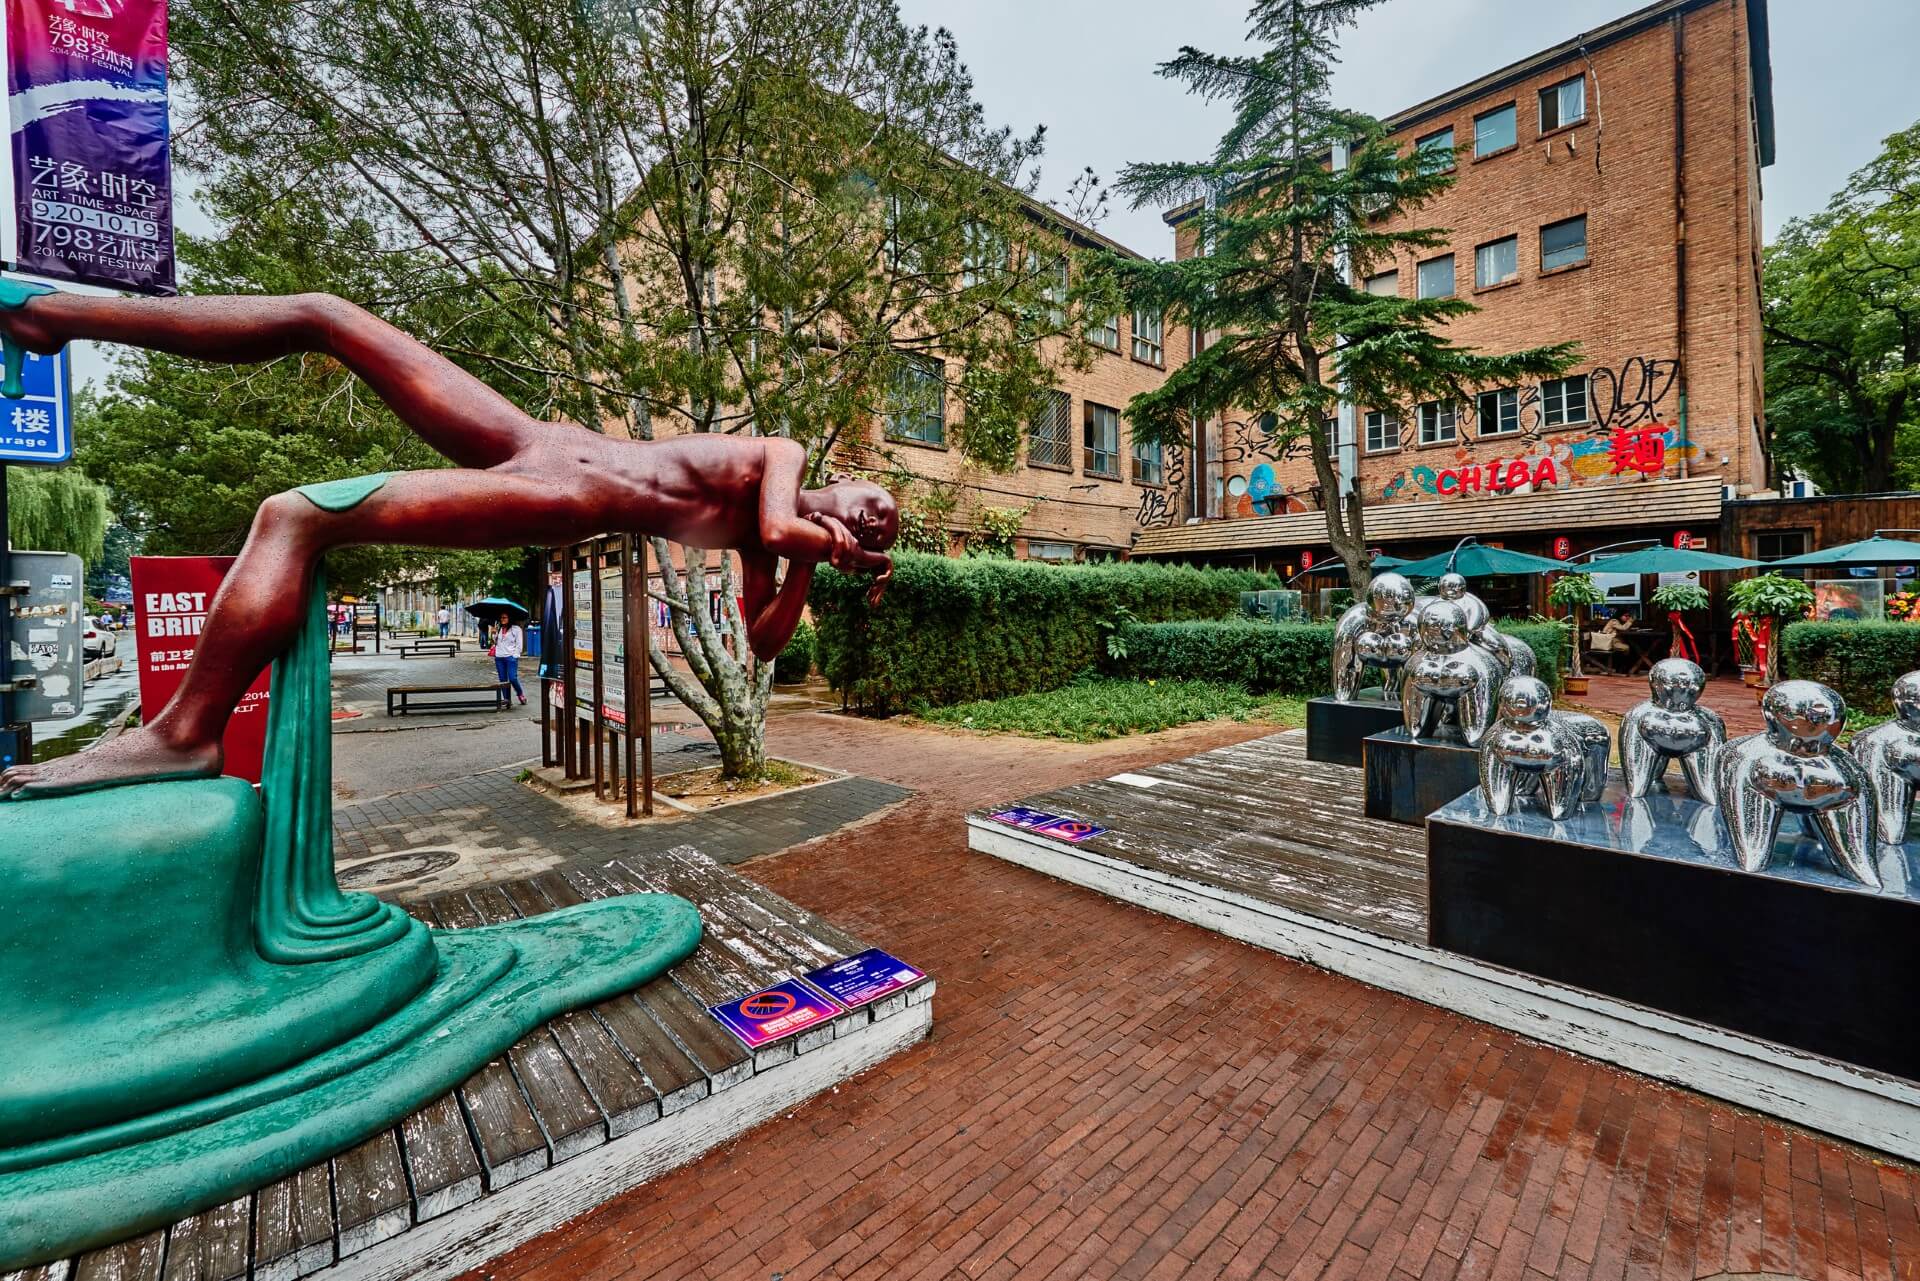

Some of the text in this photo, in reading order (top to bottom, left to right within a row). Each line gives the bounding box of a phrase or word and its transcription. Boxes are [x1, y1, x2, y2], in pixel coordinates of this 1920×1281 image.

[49, 45, 133, 78] 2014 ART FESTIVAL
[32, 188, 158, 221] ART TIME SPACE
[34, 202, 157, 238] 9.20-10.19
[33, 245, 161, 275] 2014 ART FESTIVAL
[10, 406, 51, 434] 楼
[1436, 457, 1557, 496] CHIBA
[145, 592, 206, 613] EAST
[161, 663, 175, 671] the
